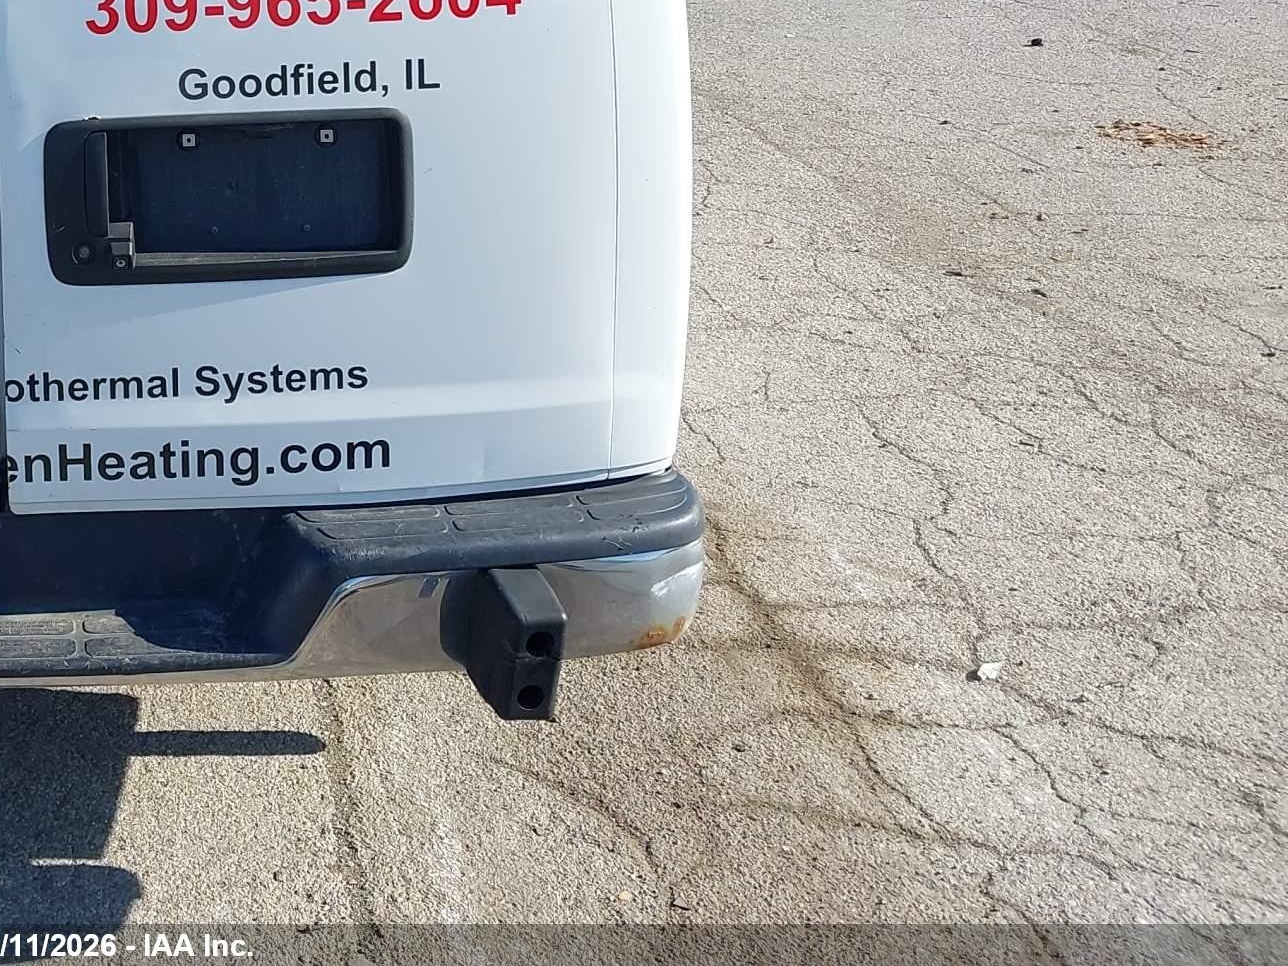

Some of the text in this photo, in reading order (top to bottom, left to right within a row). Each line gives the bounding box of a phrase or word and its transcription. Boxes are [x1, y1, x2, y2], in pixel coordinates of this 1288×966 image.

[178, 58, 441, 101] Goodfield, IL
[194, 363, 368, 405] Systems
